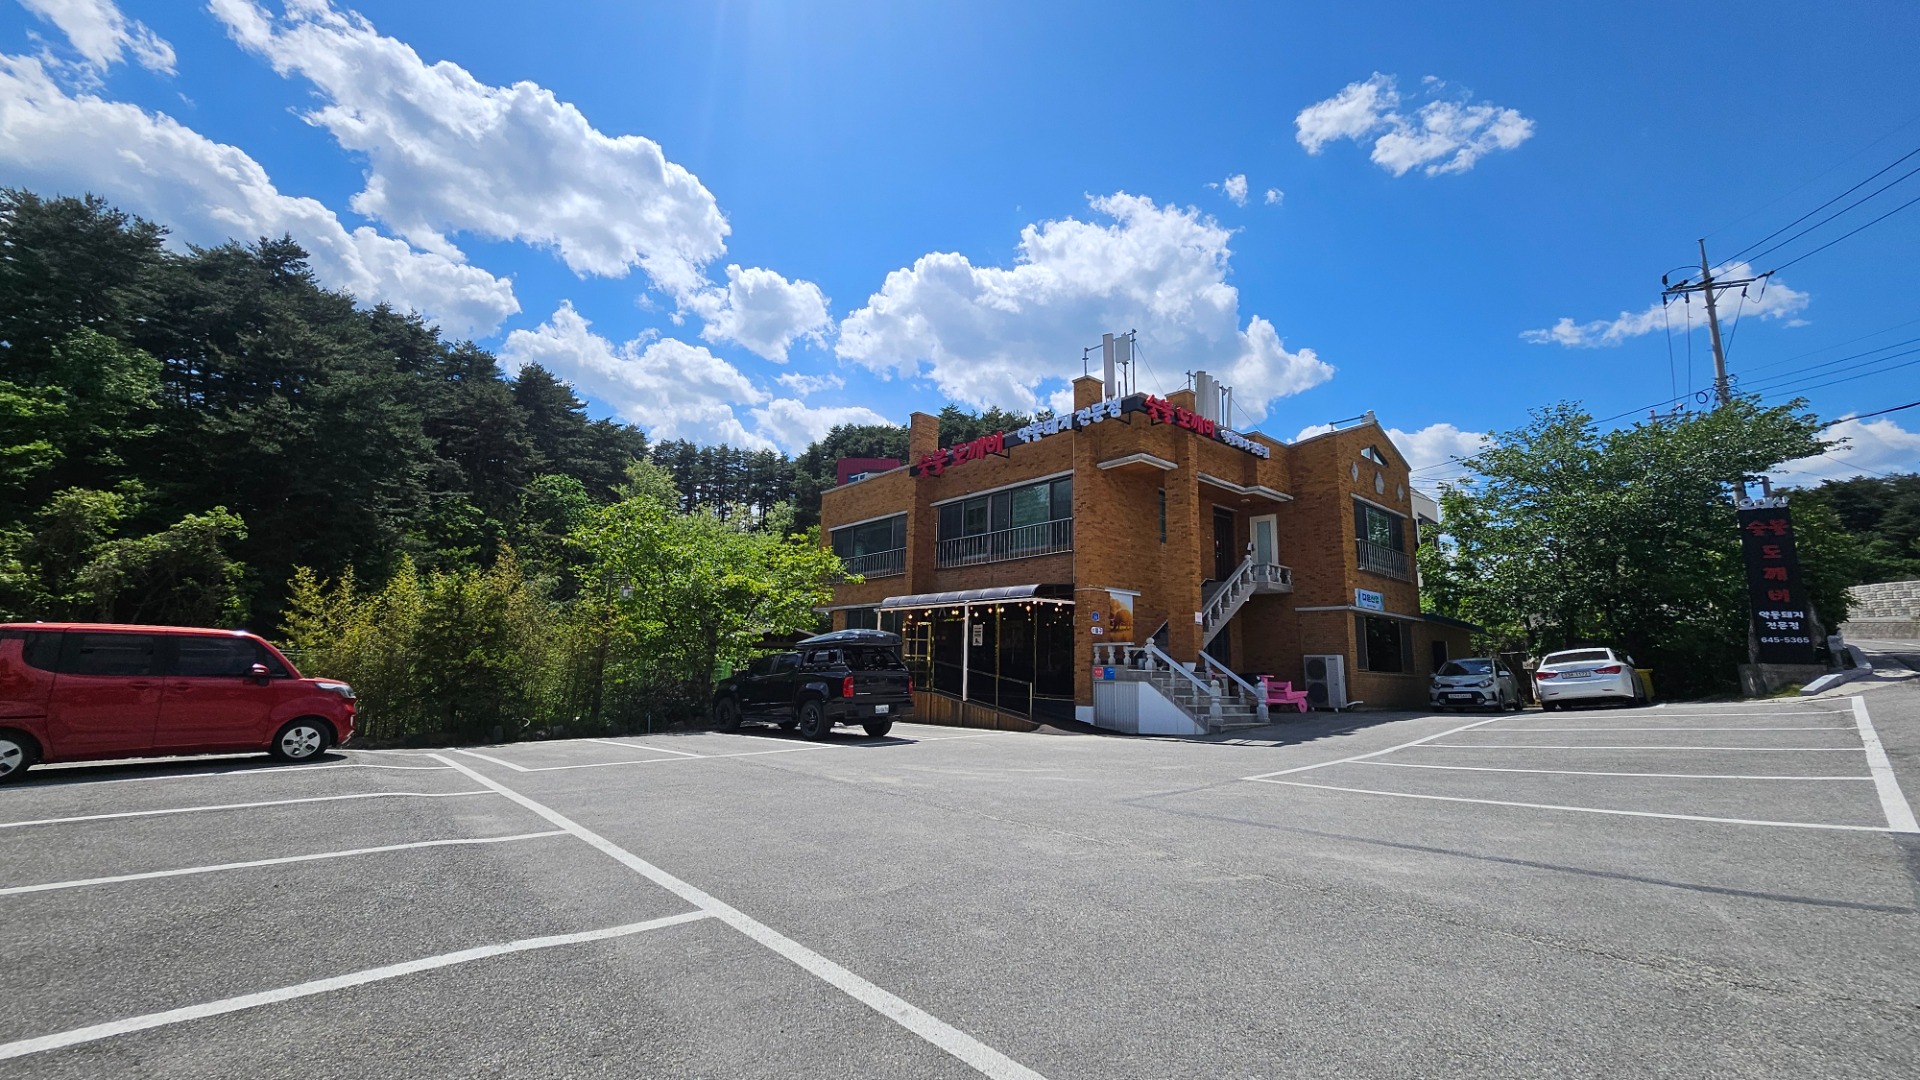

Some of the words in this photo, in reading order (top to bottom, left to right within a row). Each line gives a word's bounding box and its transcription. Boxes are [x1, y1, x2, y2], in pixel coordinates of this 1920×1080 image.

[952, 430, 1004, 466] 도깨비
[1075, 398, 1122, 427] 전문점
[1176, 406, 1215, 438] 도깨비
[1762, 544, 1790, 602] 도깨비
[1760, 636, 1810, 644] 645-5365
[1765, 621, 1800, 631] 전문점
